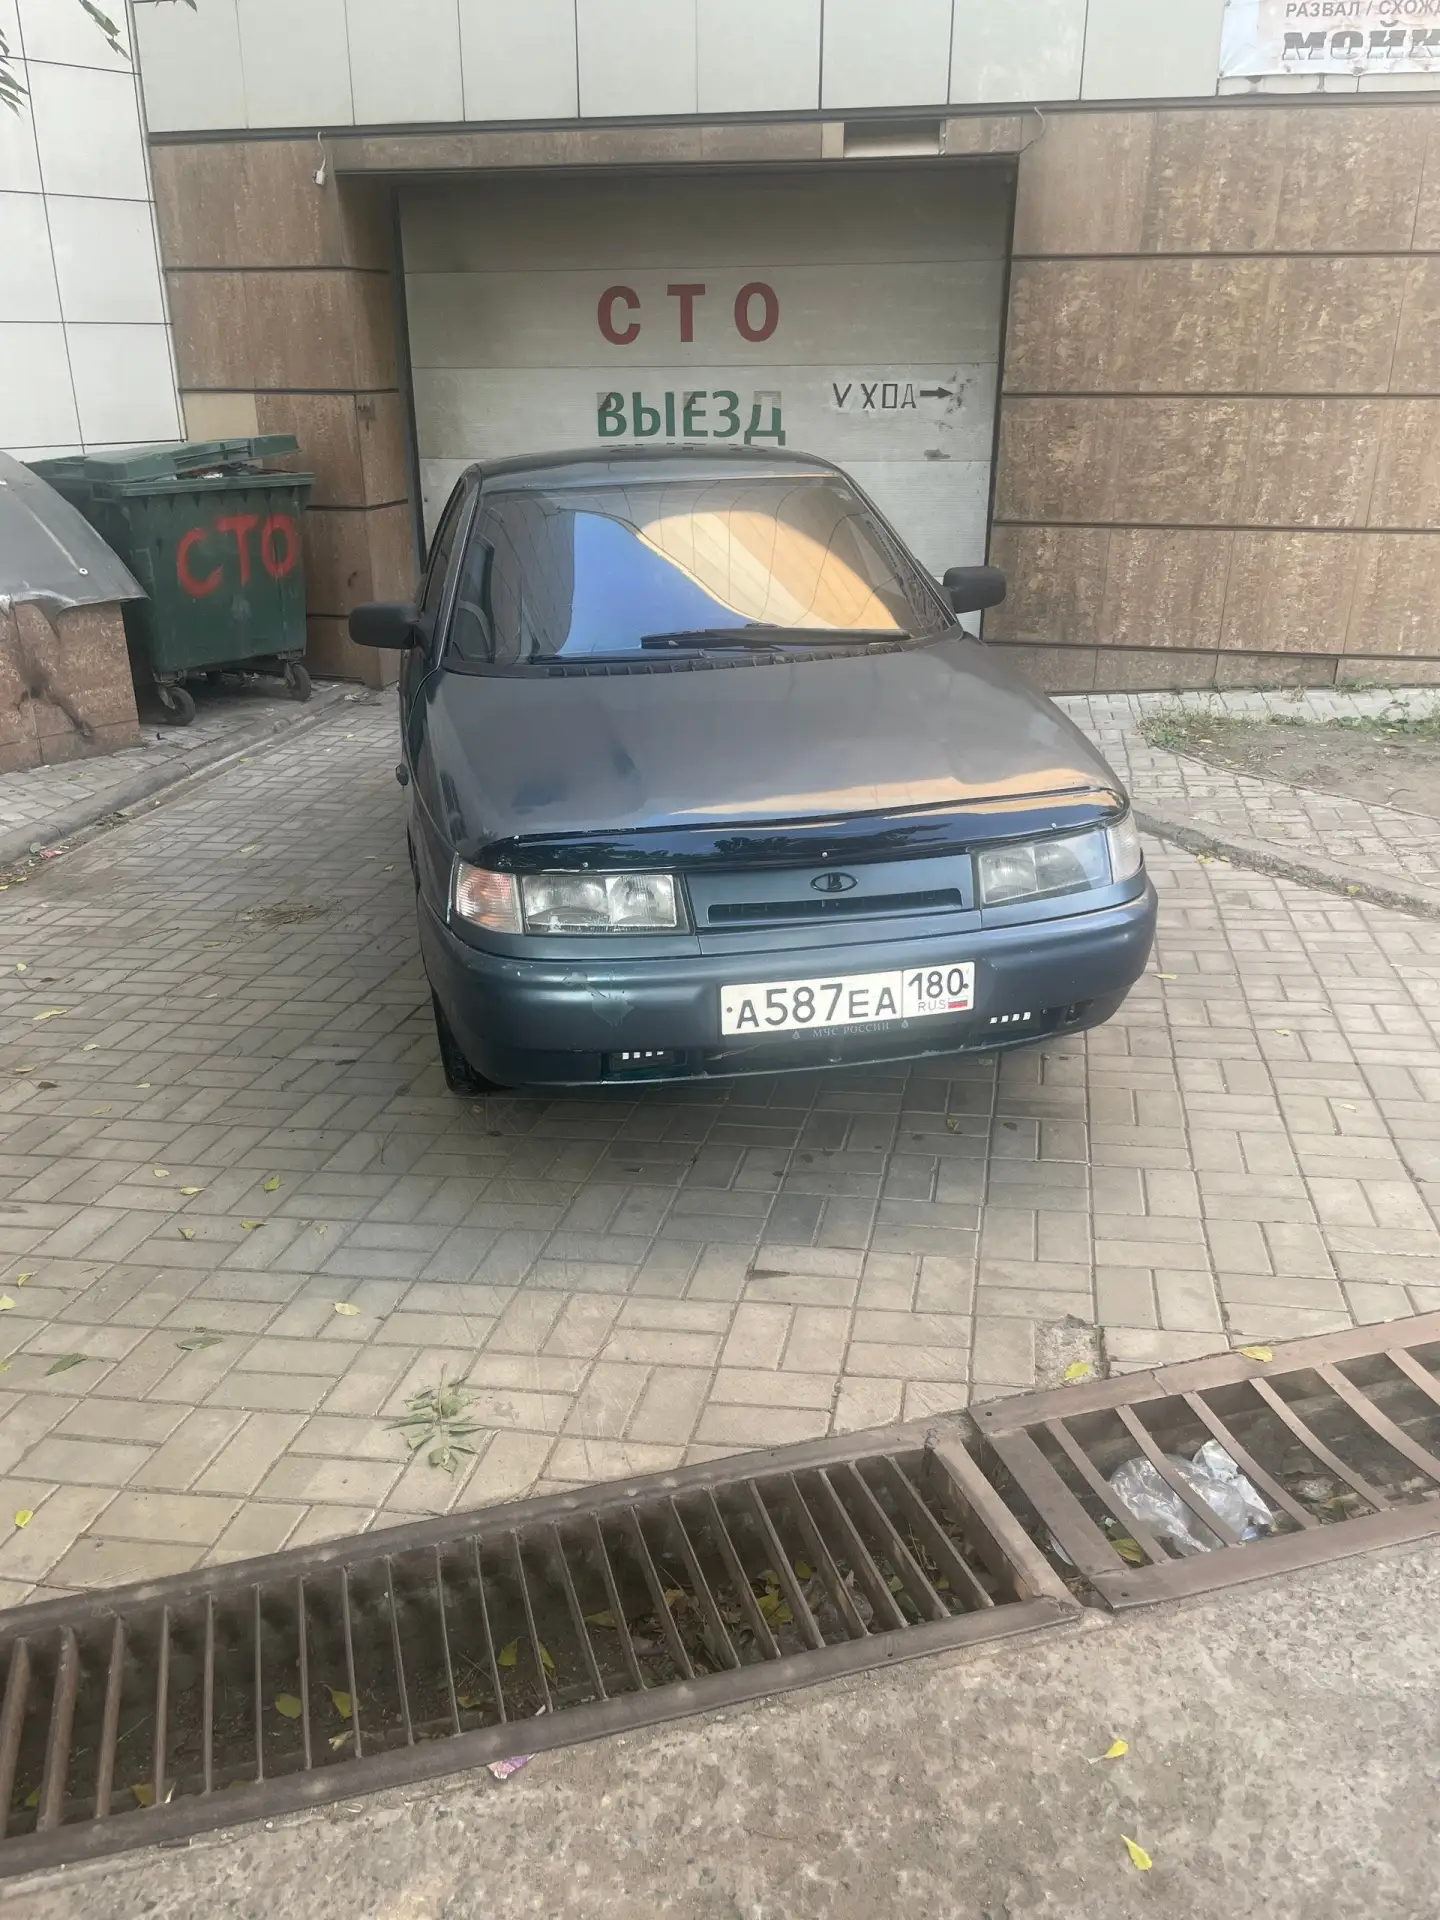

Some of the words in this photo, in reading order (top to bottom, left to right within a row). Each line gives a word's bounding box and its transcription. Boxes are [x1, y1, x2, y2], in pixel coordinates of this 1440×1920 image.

[1286, 2, 1361, 17] РАЗВАЛ
[597, 390, 786, 446] ВЫЕЗД
[177, 514, 299, 598] СТО
[917, 999, 947, 1013] RUS
[812, 1028, 838, 1038] МЧС
[843, 1021, 890, 1035] РОССИИ
